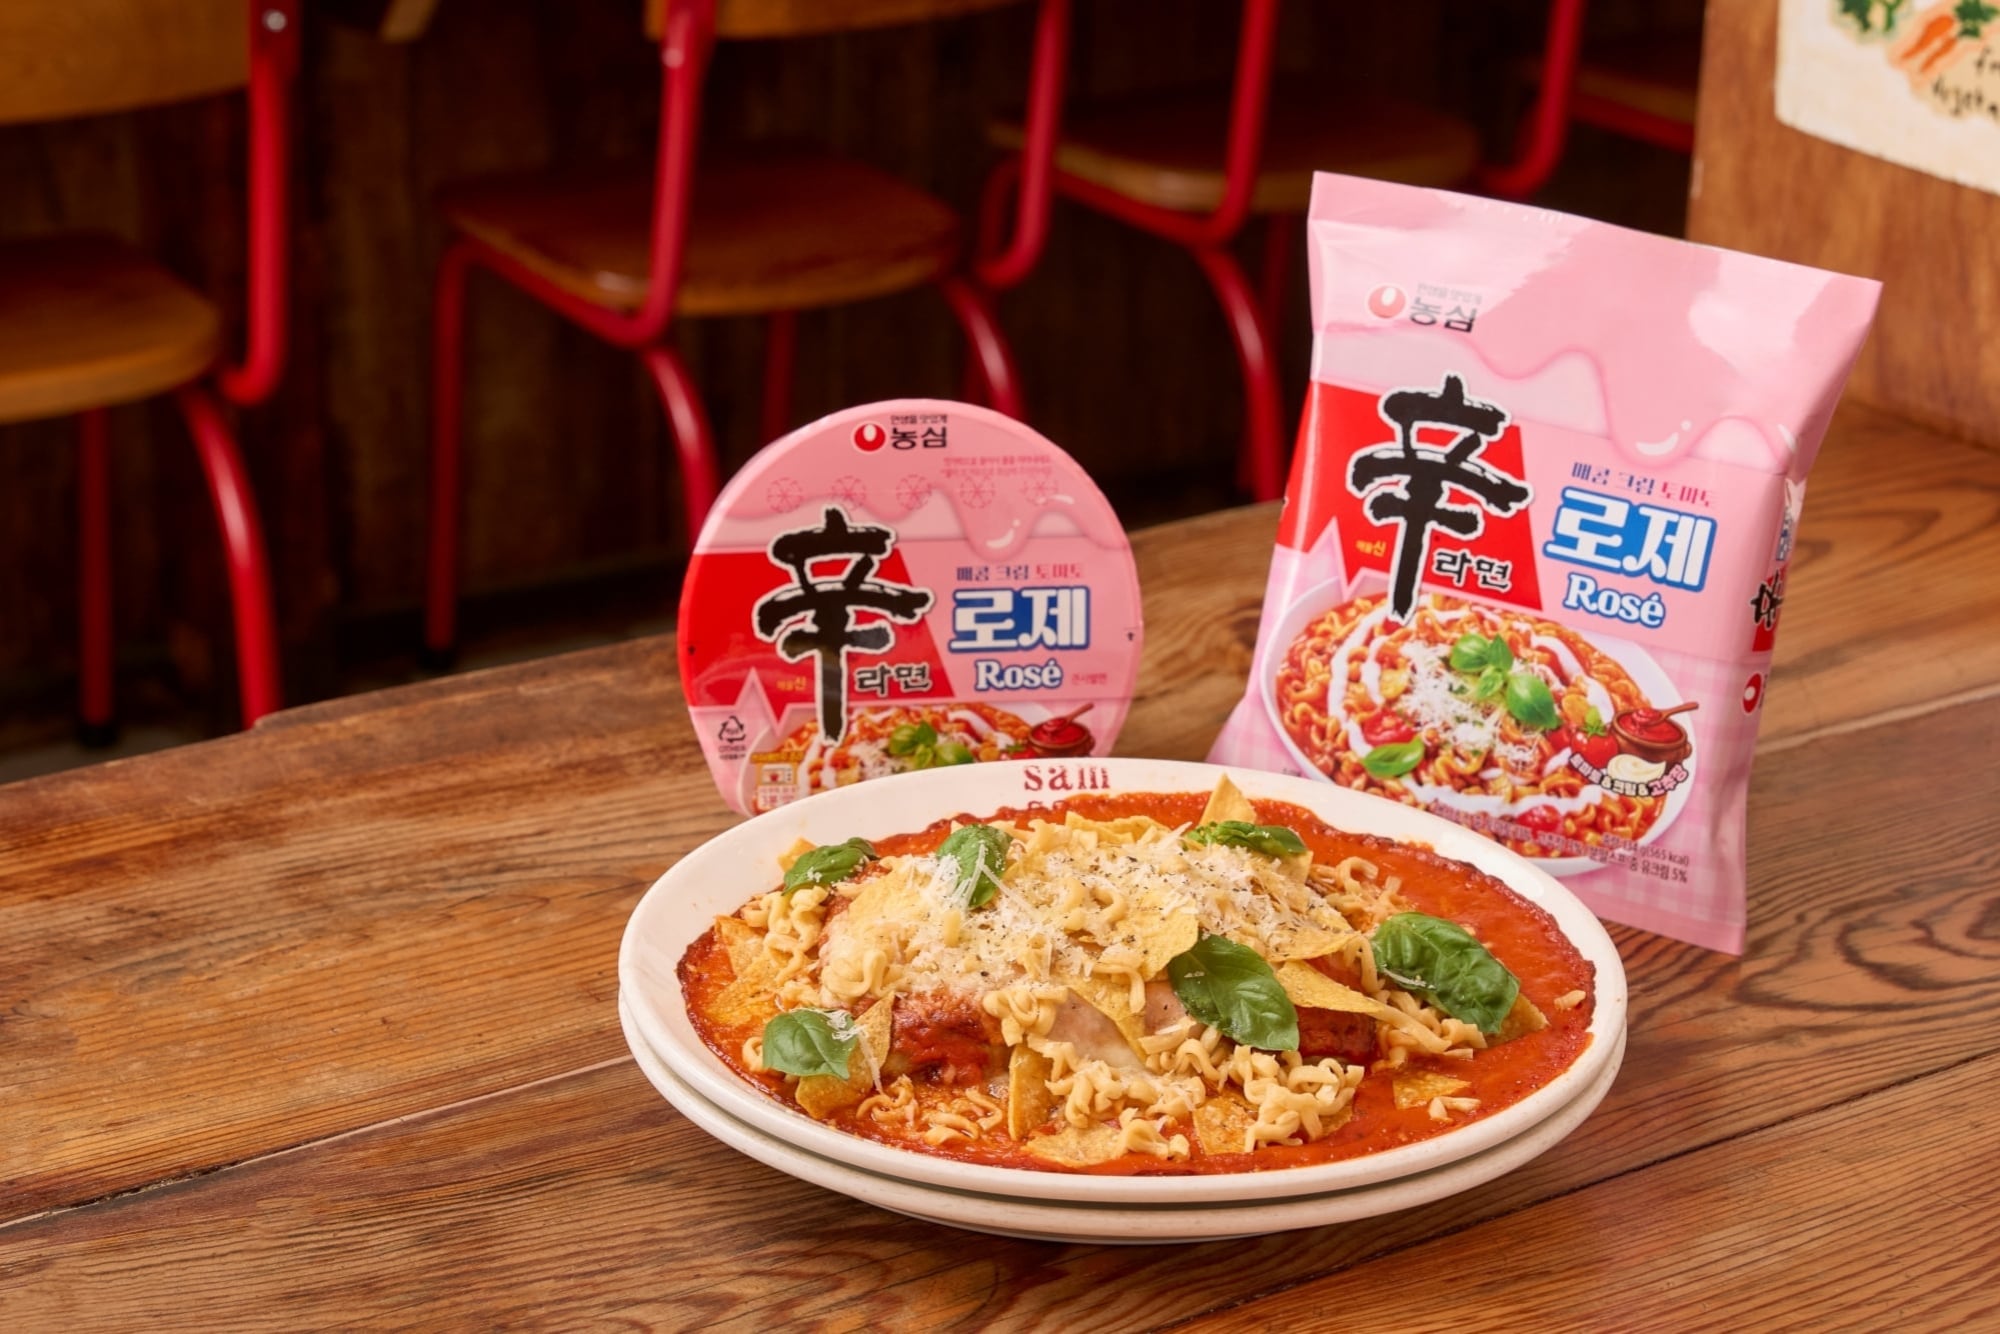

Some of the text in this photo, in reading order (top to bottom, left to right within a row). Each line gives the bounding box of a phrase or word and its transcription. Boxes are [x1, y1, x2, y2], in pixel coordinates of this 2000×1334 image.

[1410, 297, 1477, 333] 농심
[891, 427, 947, 450] 농심
[1348, 372, 1531, 623] 辛
[1543, 486, 1717, 593] 로제
[1434, 549, 1512, 591] 라면
[753, 506, 933, 744] 辛
[948, 586, 1091, 653] 로제
[1563, 572, 1666, 629] Rosé
[855, 663, 931, 696] 라면
[974, 658, 1063, 692] Rosé
